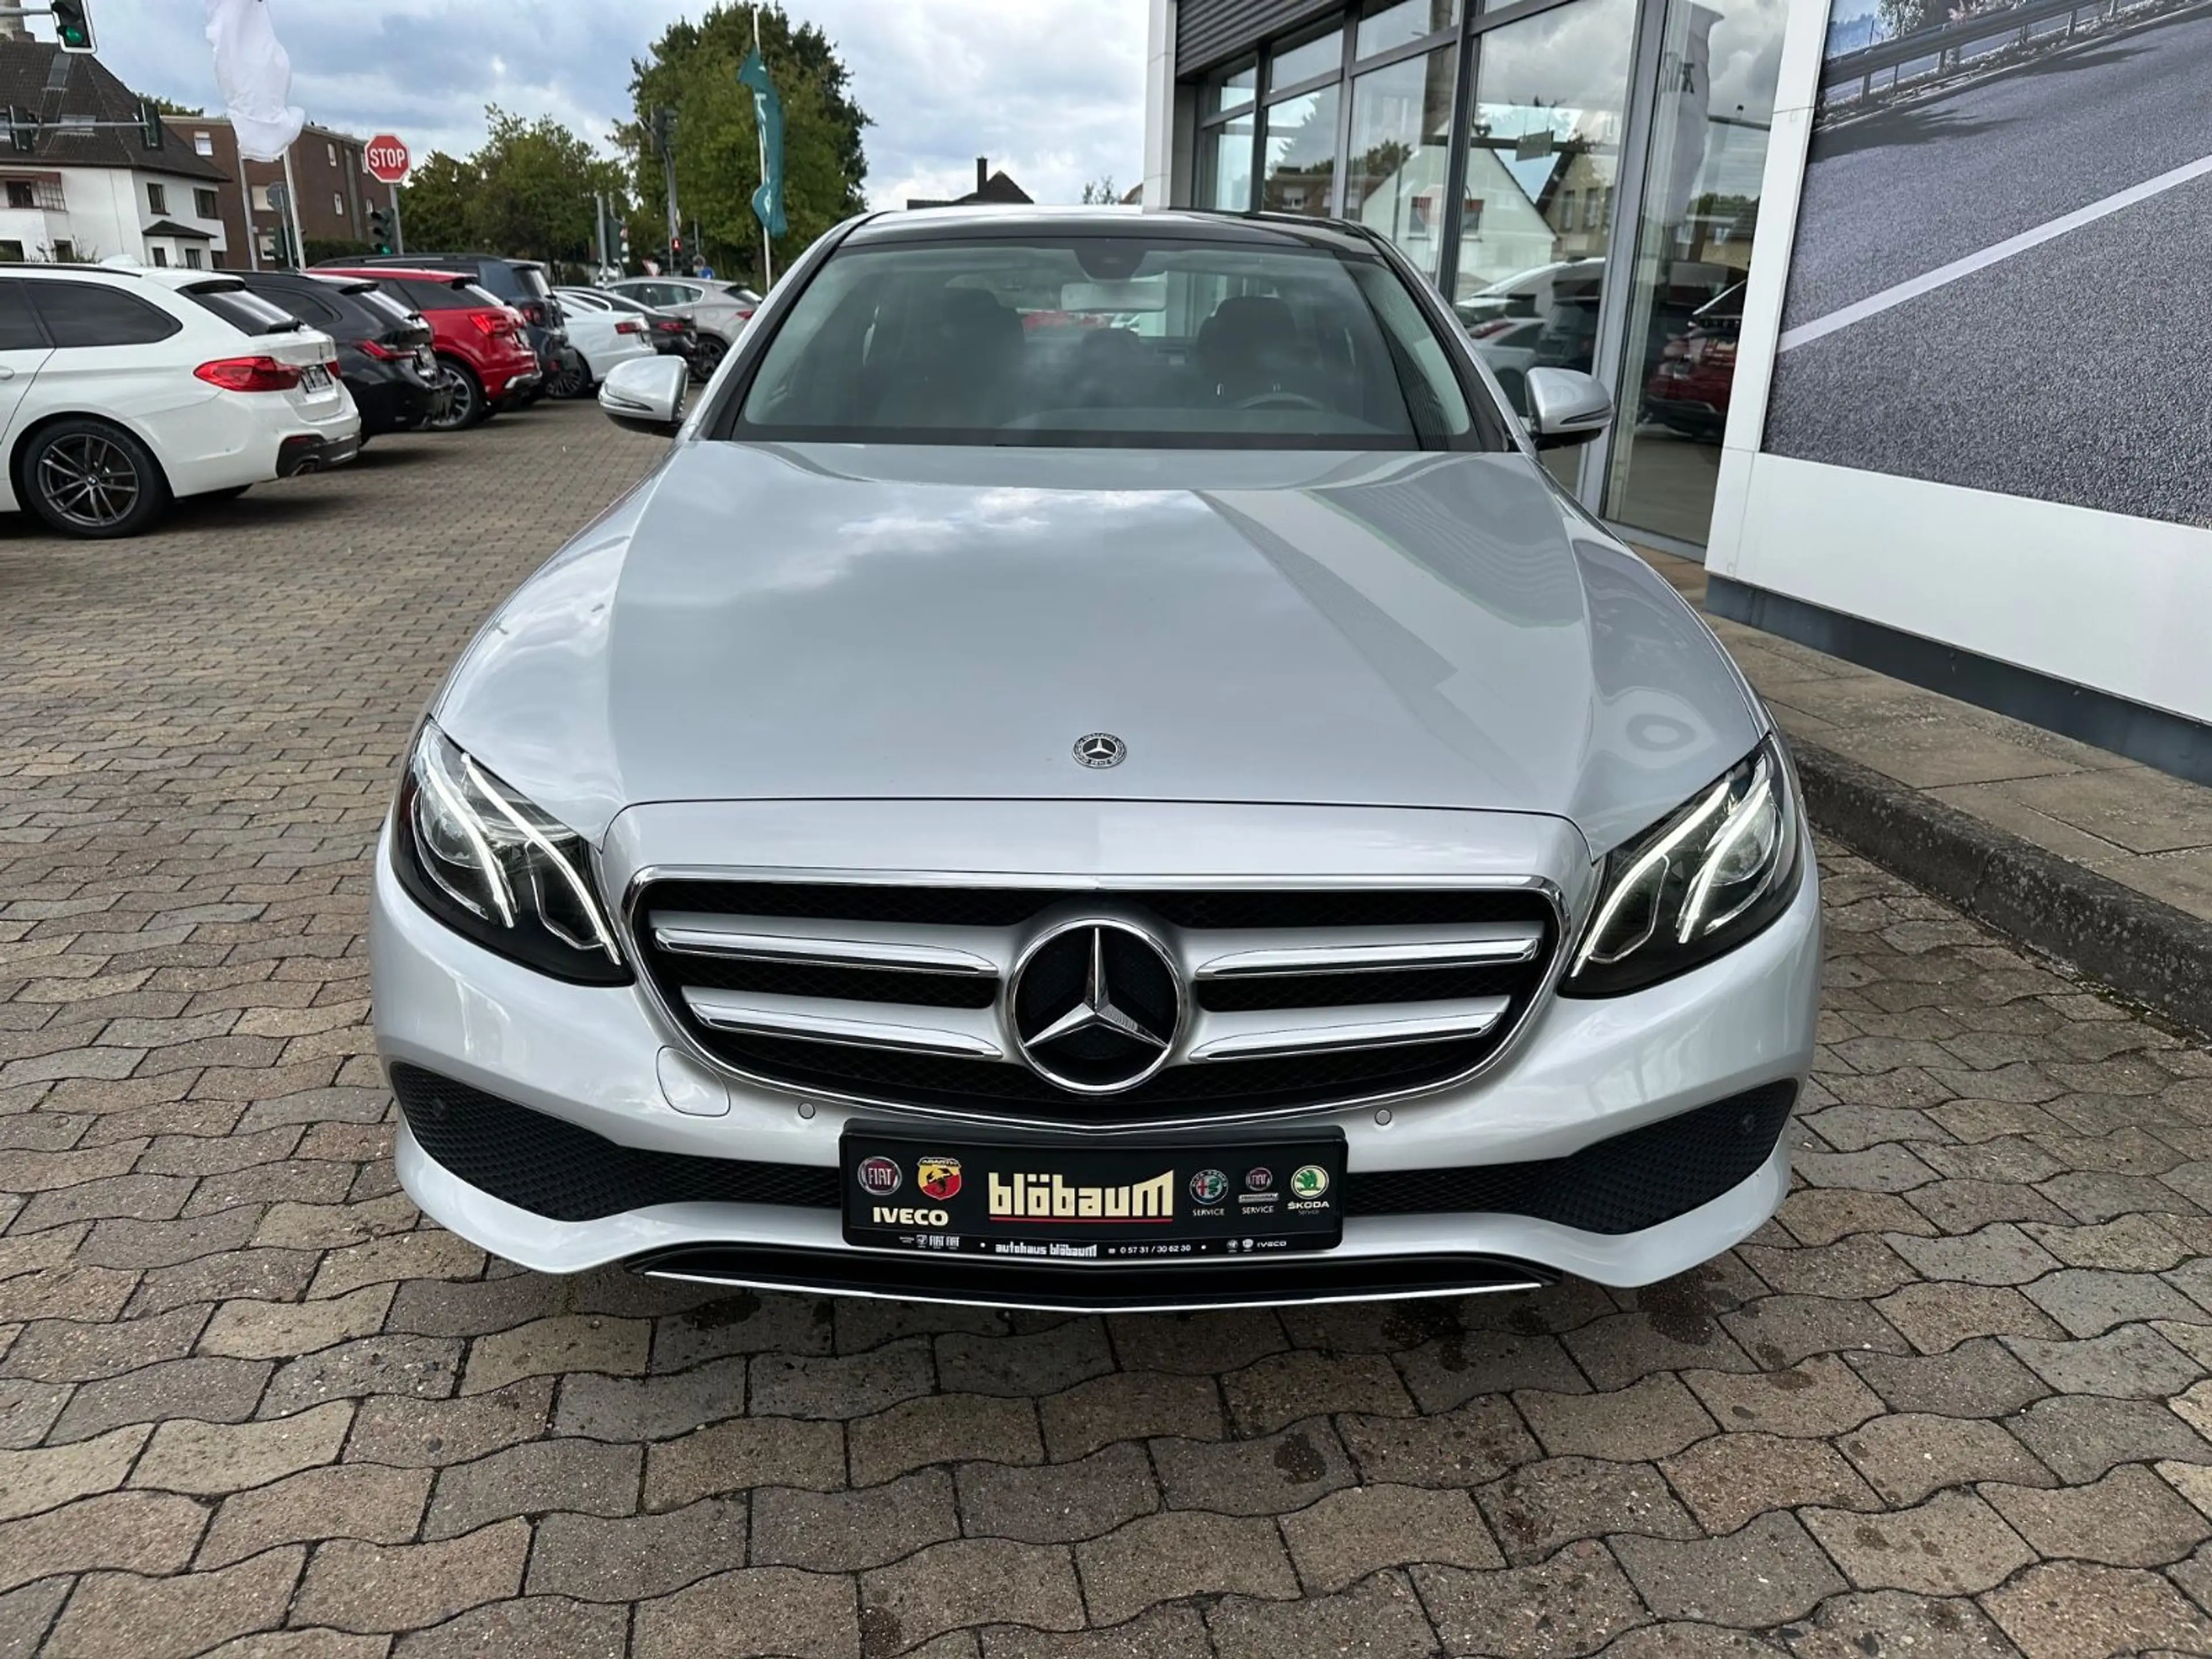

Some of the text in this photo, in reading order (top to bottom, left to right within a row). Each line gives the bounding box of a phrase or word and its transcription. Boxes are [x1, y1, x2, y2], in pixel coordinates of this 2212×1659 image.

[370, 147, 406, 168] STOP
[868, 1168, 893, 1186] FIAT
[1241, 1205, 1275, 1215] SERVICE
[1287, 1200, 1330, 1210] ŠKODA
[873, 1207, 949, 1226] IVECO
[1192, 1208, 1225, 1217] SERVICE
[995, 1241, 1047, 1255] autohaus
